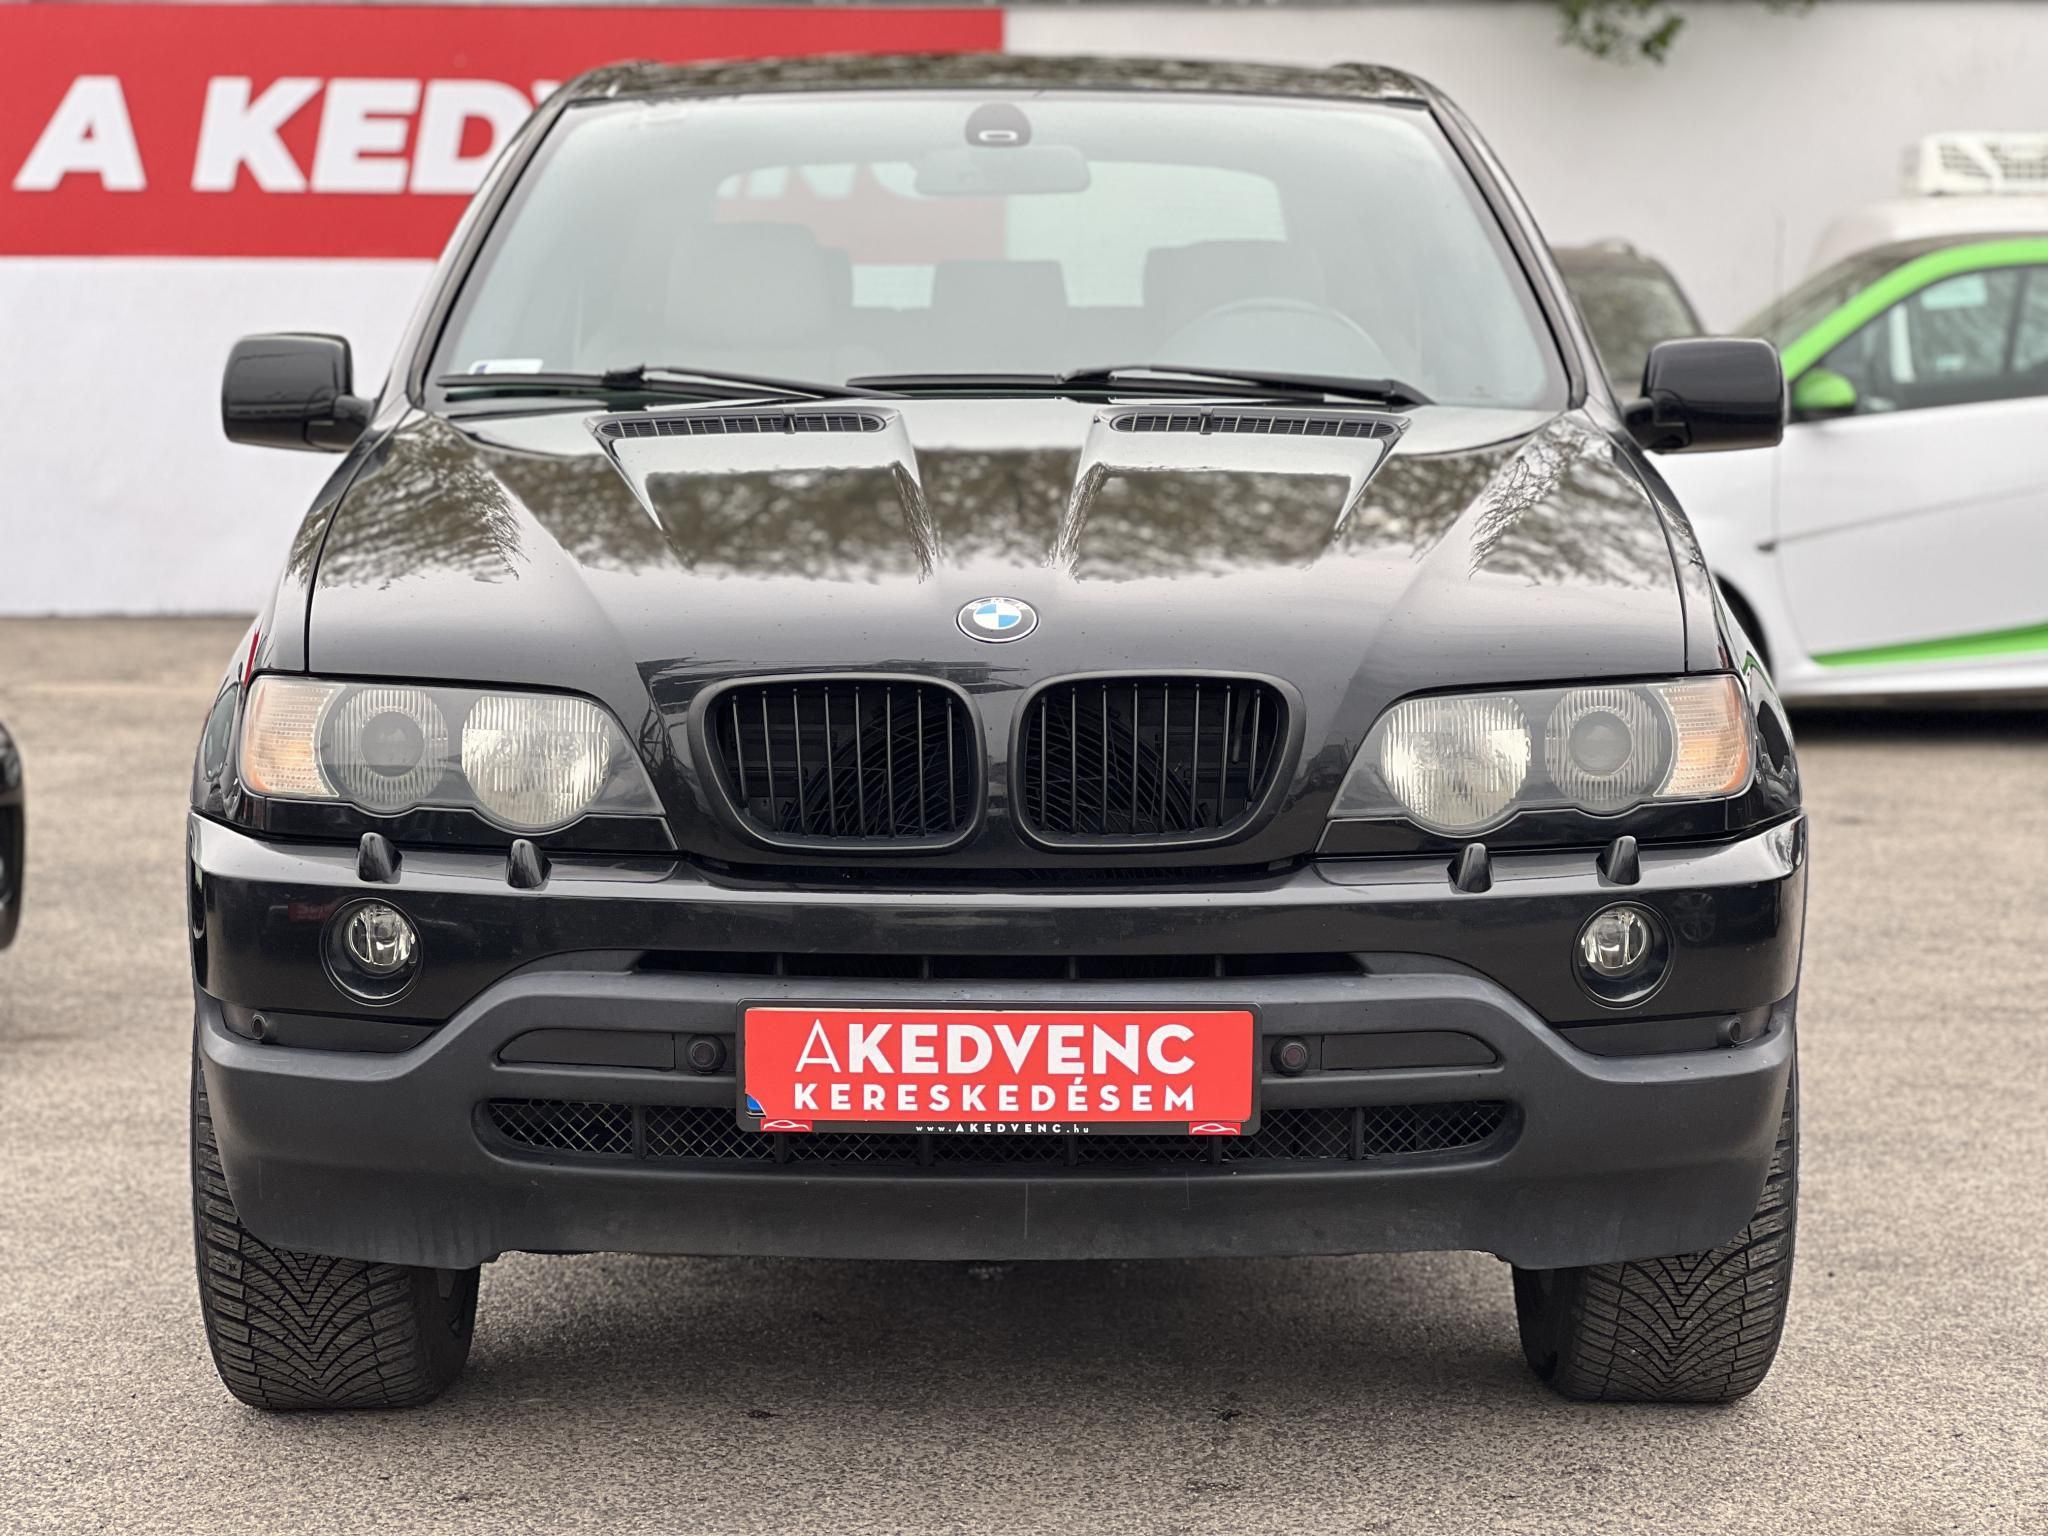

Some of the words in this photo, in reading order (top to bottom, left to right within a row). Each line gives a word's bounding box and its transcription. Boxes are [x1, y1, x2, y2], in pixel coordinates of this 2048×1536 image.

[13, 75, 146, 191] A
[192, 77, 560, 193] KED
[794, 1077, 1194, 1112] KERESKEDÉSEM
[915, 1122, 1089, 1134] www.AKEDVENC.hu
